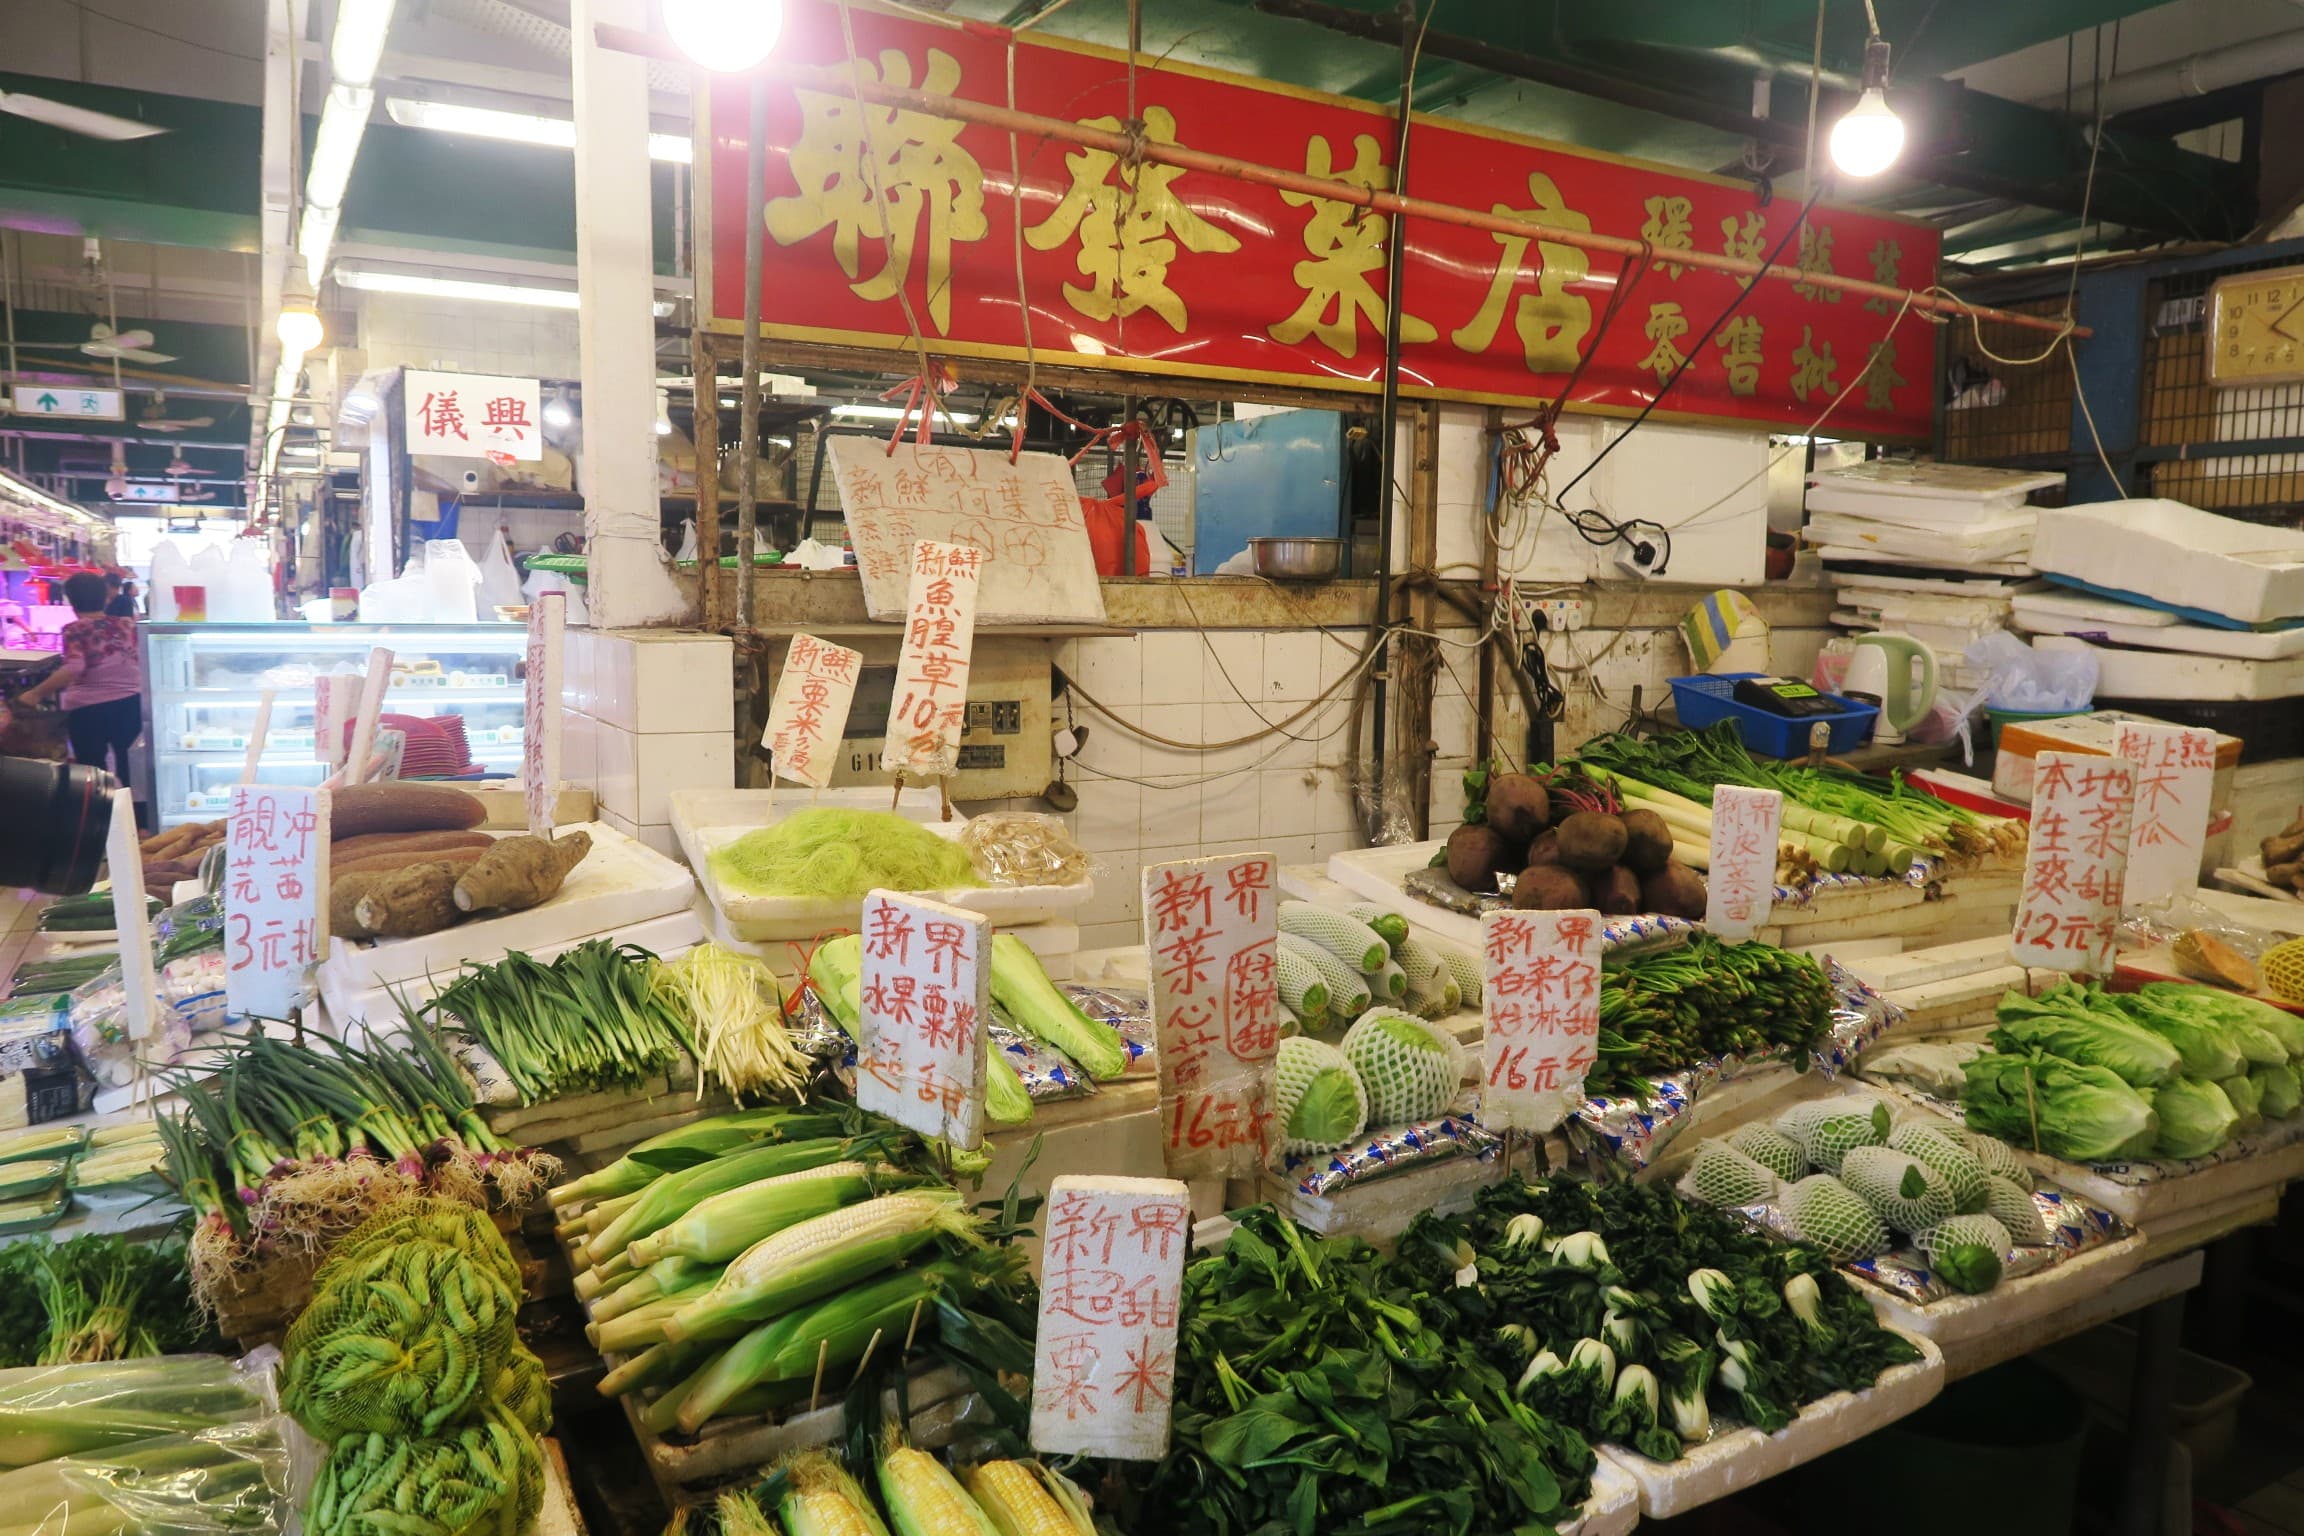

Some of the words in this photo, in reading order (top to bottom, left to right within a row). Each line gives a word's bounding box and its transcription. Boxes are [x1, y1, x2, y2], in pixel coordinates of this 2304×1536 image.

[2229, 306, 2243, 320] 10
[2247, 292, 2259, 306] 11
[2267, 289, 2281, 304] 12
[2229, 325, 2239, 338] 9
[2229, 344, 2240, 358] 8
[1637, 302, 1910, 411] 零售批發
[416, 389, 532, 441] 儀興
[915, 540, 983, 581] 新鮮
[790, 636, 857, 683] 新鮮
[2119, 726, 2214, 769] 樹上熟
[2035, 757, 2136, 805] 本地
[2131, 769, 2190, 849] 木瓜
[1150, 859, 1271, 932] 新界
[865, 897, 971, 990] 新界
[1486, 915, 1594, 965] 新界
[1488, 953, 1600, 1002] 白菜仔
[1049, 1190, 1187, 1265] 新界
[1045, 1264, 1179, 1329] 超甜
